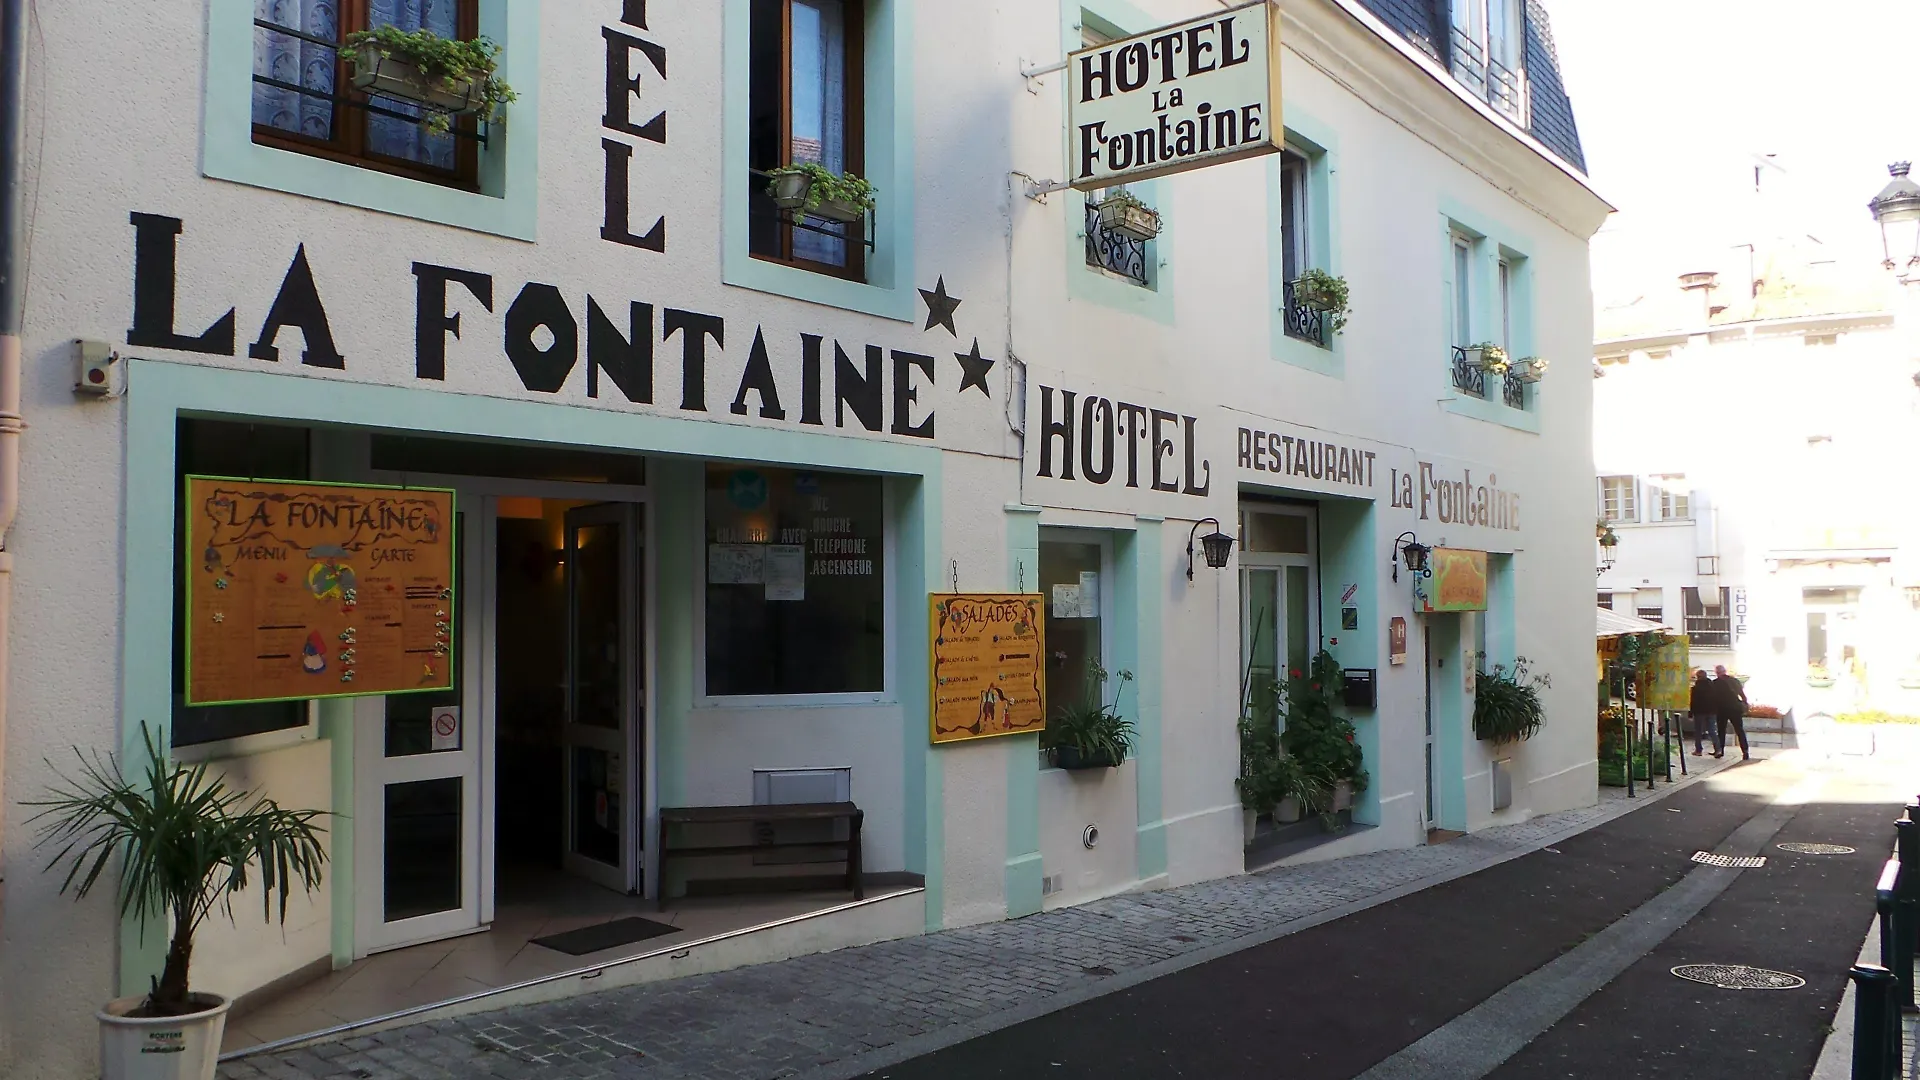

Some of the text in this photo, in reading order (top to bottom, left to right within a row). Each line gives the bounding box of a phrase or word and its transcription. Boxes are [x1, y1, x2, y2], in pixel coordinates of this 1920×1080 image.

[1079, 16, 1250, 103] HOTEL
[1152, 87, 1184, 113] La
[127, 210, 935, 439] LA FONTAINE
[1036, 384, 1210, 497] HOTEL
[1238, 427, 1376, 487] RESTAURANT
[1390, 468, 1414, 509] La
[227, 499, 424, 546] LA FONTAINE
[781, 528, 808, 544] AVEC
[234, 546, 416, 569] MENU CARTE
[961, 604, 1018, 634] SALADES
